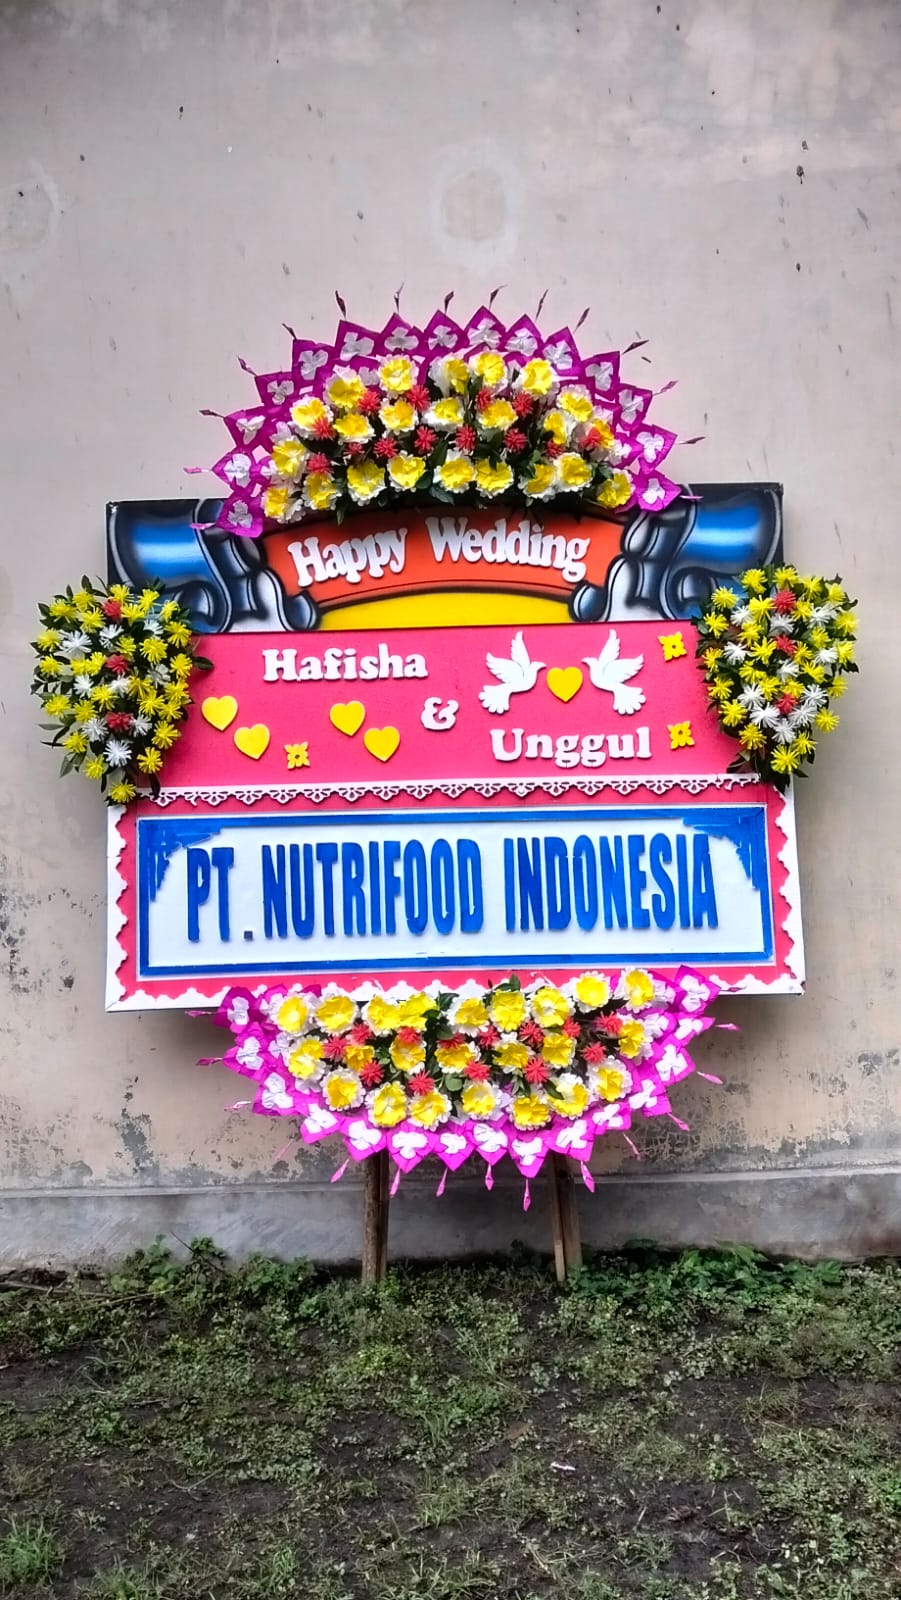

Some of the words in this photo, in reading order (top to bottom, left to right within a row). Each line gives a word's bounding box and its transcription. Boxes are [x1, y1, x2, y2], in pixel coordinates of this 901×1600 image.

[288, 527, 408, 587] Happy
[425, 516, 590, 583] Wedding
[262, 643, 428, 682] Hafisha
[420, 697, 459, 731] &
[490, 727, 652, 768] Unggul
[262, 838, 484, 938] NUTRIFOOD
[504, 833, 719, 932] INDONESIA
